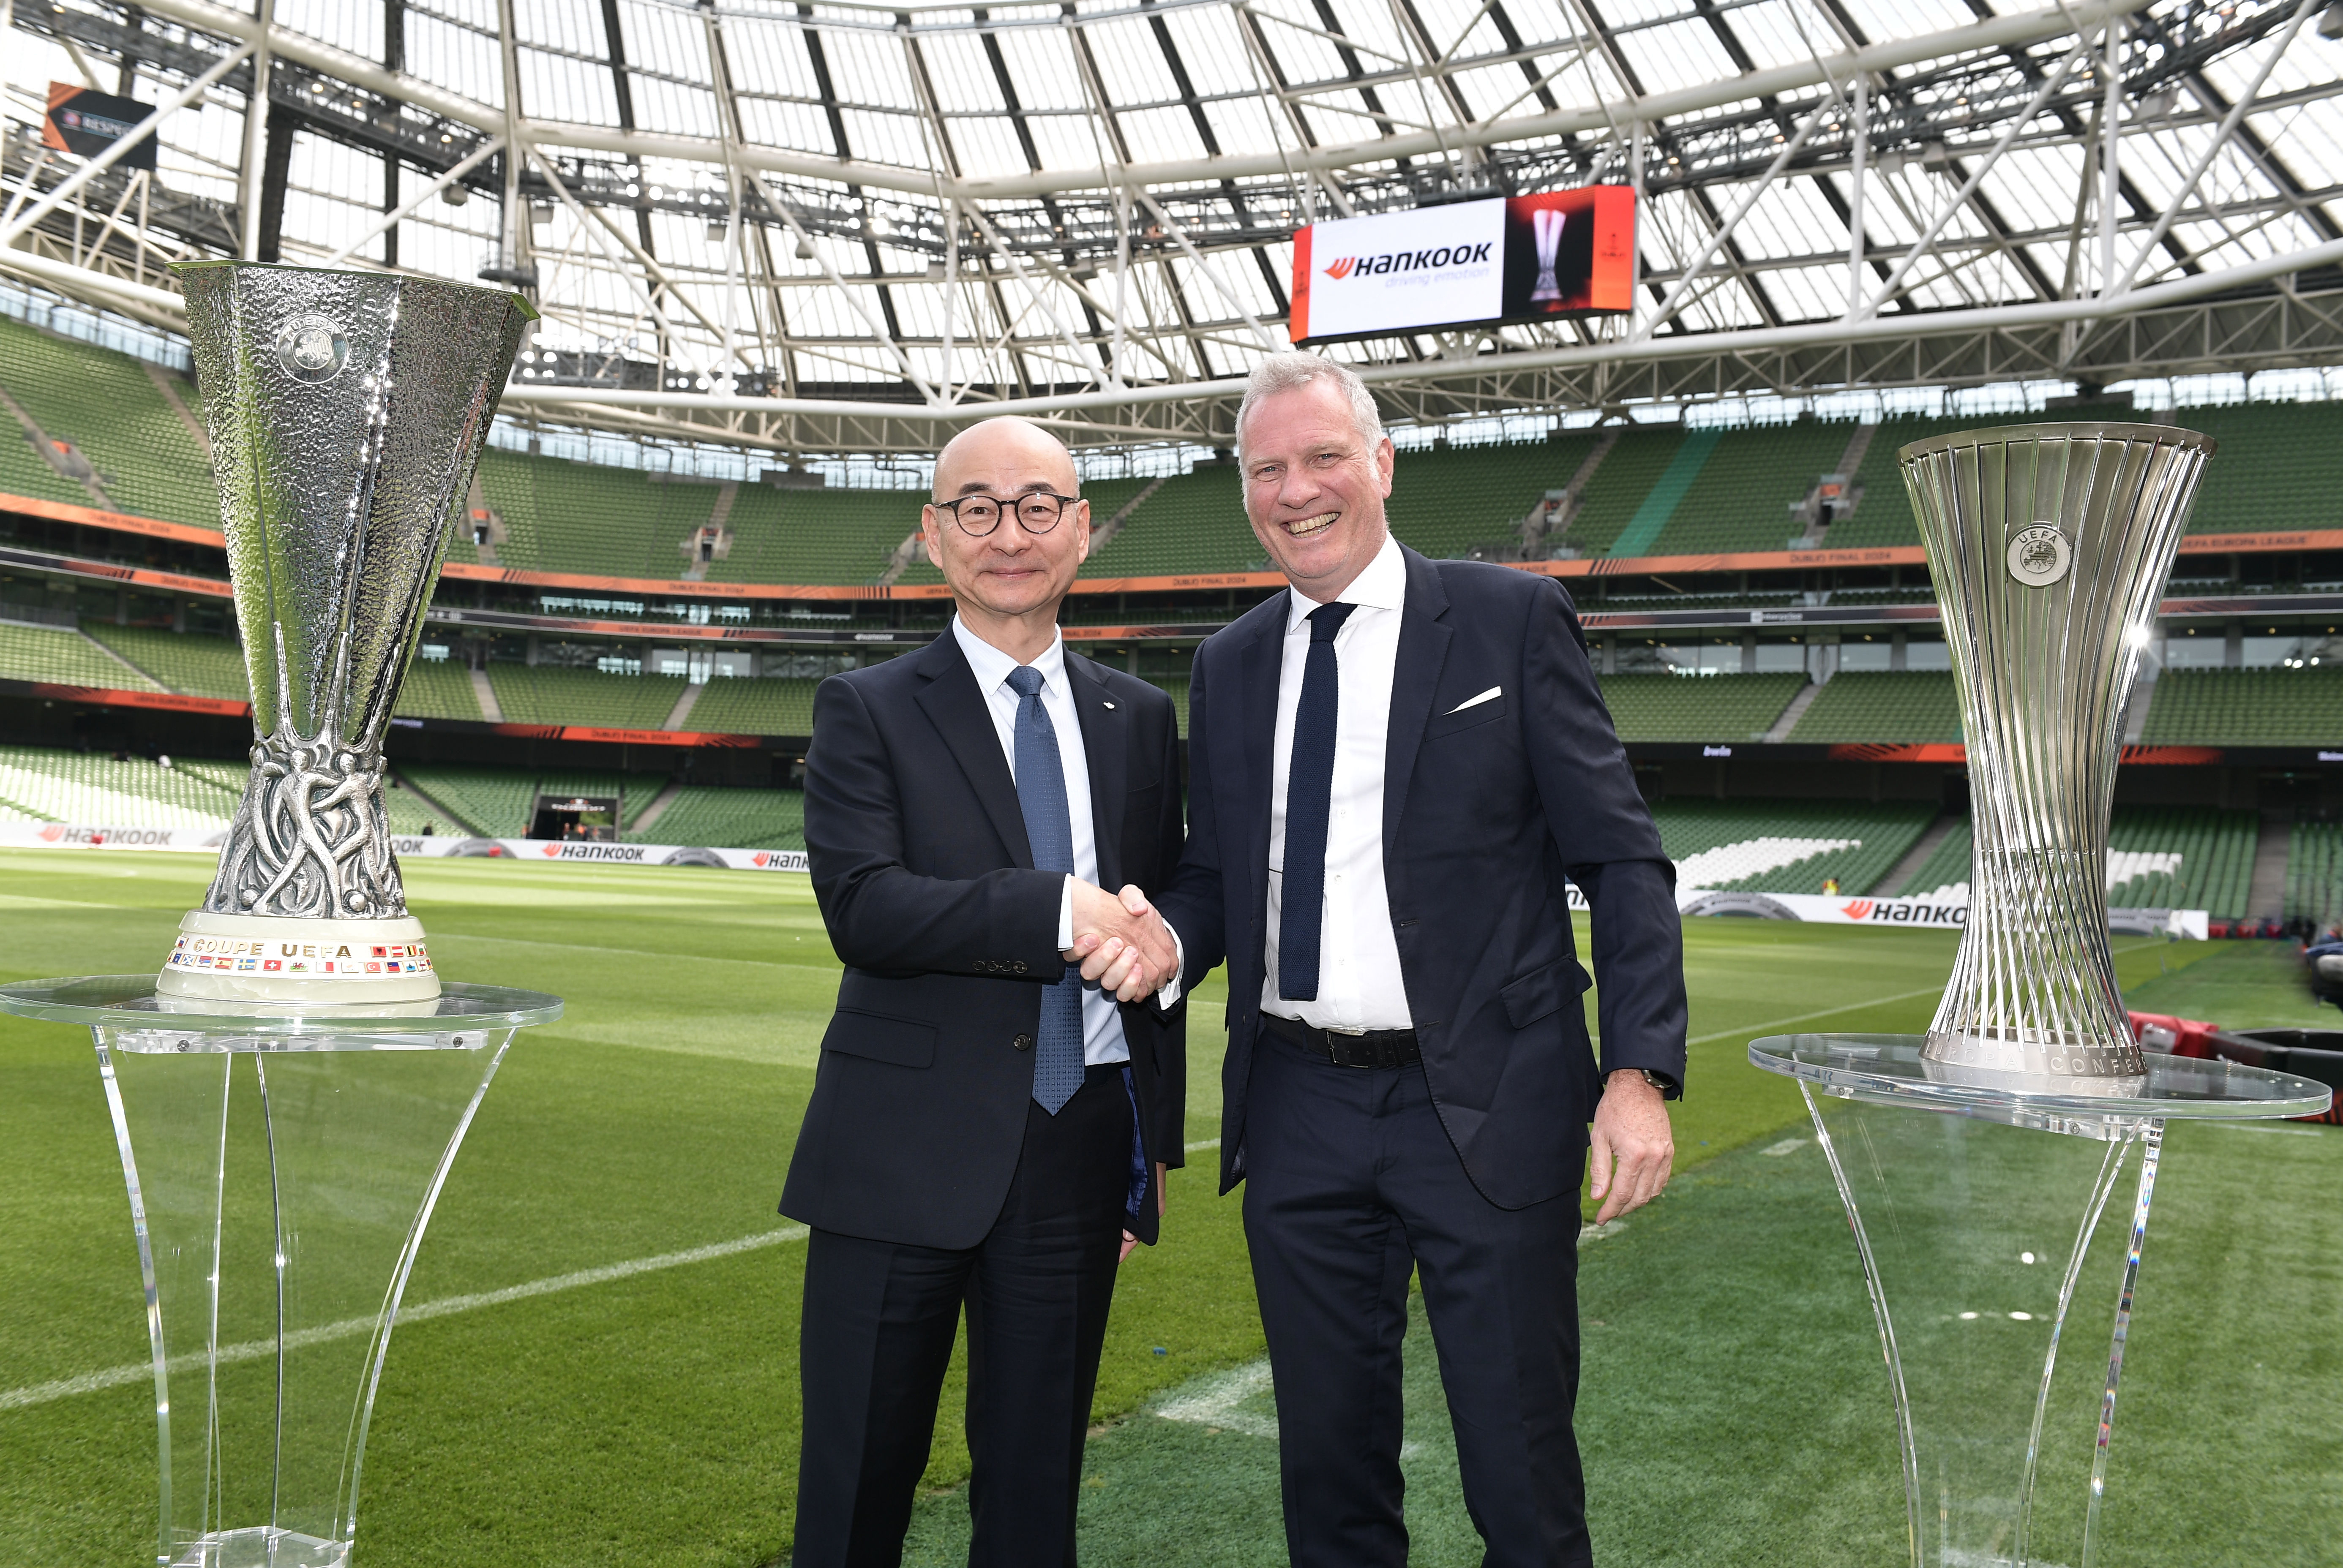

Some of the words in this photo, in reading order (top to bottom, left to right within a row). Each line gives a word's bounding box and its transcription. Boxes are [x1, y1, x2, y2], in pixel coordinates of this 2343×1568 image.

[1385, 272, 1431, 288] driving
[1434, 267, 1489, 284] emotion
[289, 317, 335, 336] UEFA
[2018, 530, 2058, 544] UEFA
[2212, 536, 2256, 547] EUROPA
[2261, 536, 2306, 544] LEAGUE
[1830, 552, 1857, 561] FINAL
[1864, 550, 1890, 560] 2024
[194, 939, 264, 956] COUPE
[281, 944, 352, 958] UEFA
[1925, 1041, 2017, 1068] EUROPA
